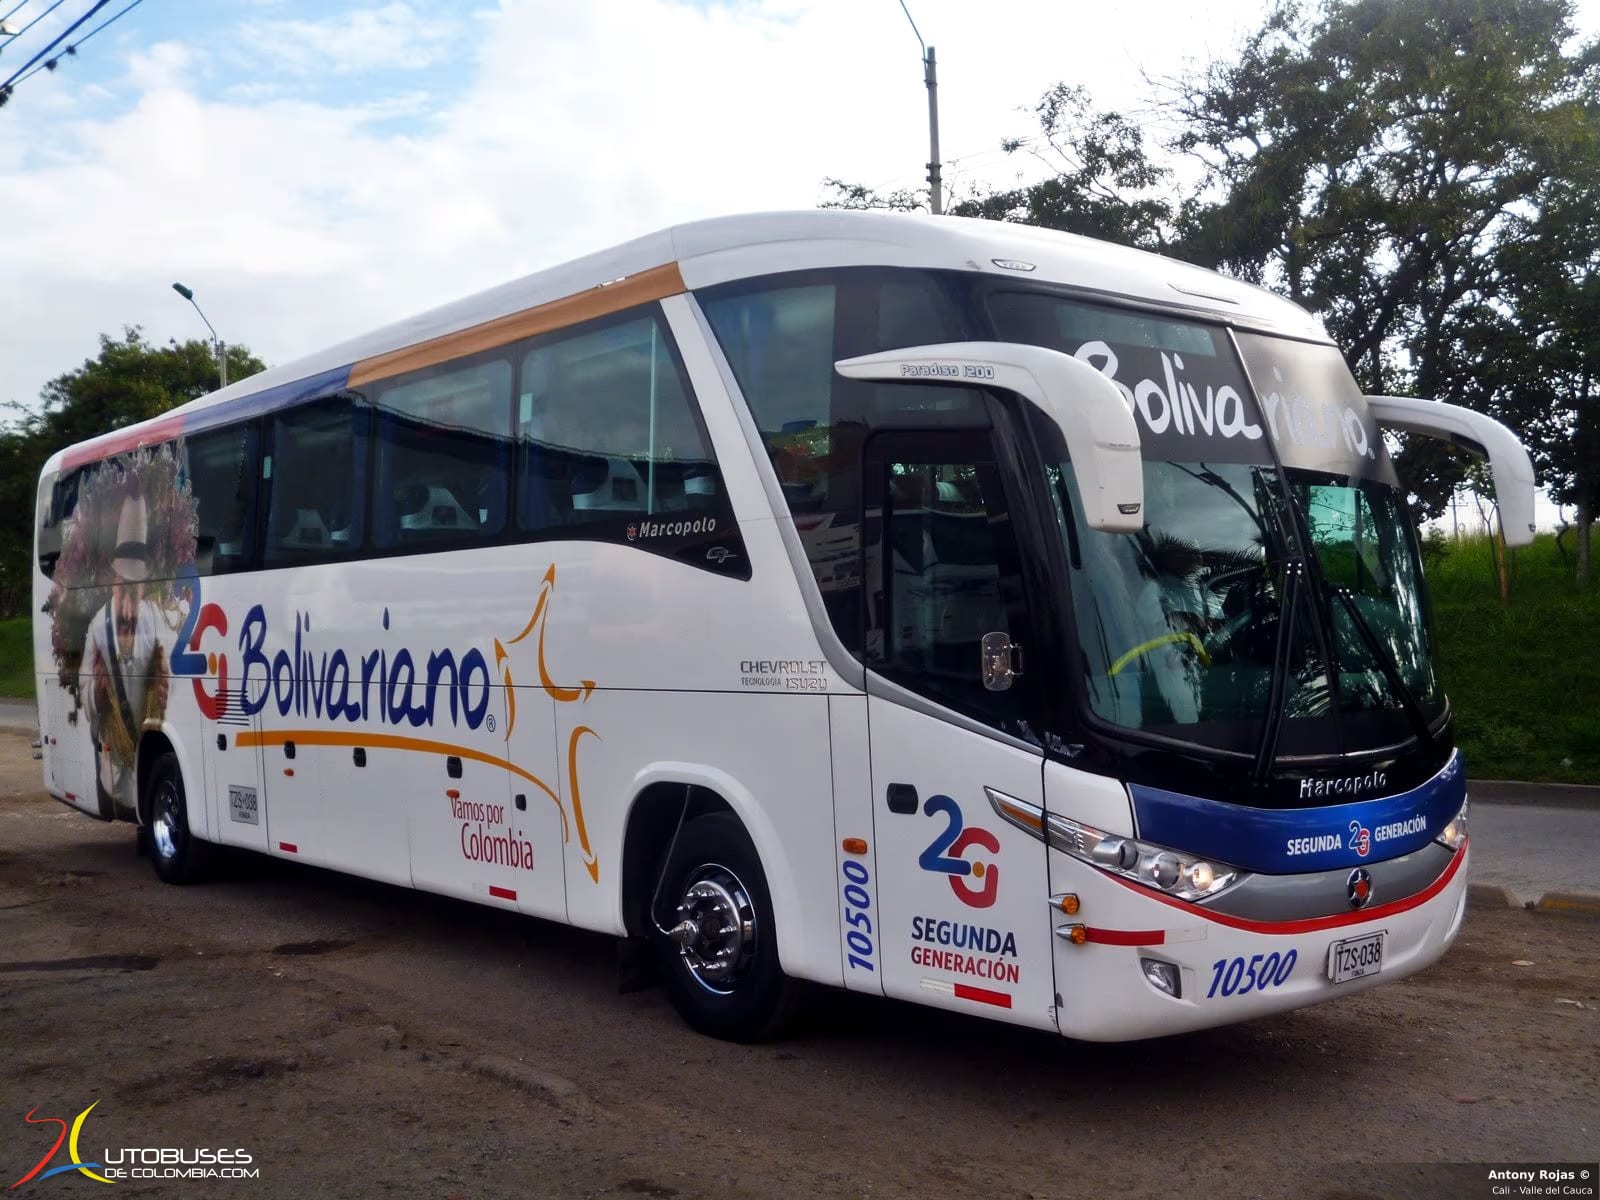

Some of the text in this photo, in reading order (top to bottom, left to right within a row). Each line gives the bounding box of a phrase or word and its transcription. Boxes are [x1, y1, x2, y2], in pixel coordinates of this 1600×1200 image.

[900, 363, 995, 380] Paradiso 1200
[639, 517, 716, 538] Marcopolo
[238, 603, 490, 731] Bolivariano
[740, 660, 827, 674] CHEVROLET
[785, 678, 827, 691] ISUZU
[1299, 771, 1387, 798] Marcopolo
[449, 796, 504, 829] Vamos por
[461, 822, 534, 871] Colombia
[1286, 834, 1342, 856] SEGUNDA
[1374, 813, 1427, 841] GENERACIÓN
[842, 860, 875, 973] 10500
[911, 916, 1017, 958] SEGUNDA
[910, 946, 1019, 983] GENERACIÓN
[1206, 949, 1298, 999] 10500
[1337, 941, 1381, 973] TZS-038
